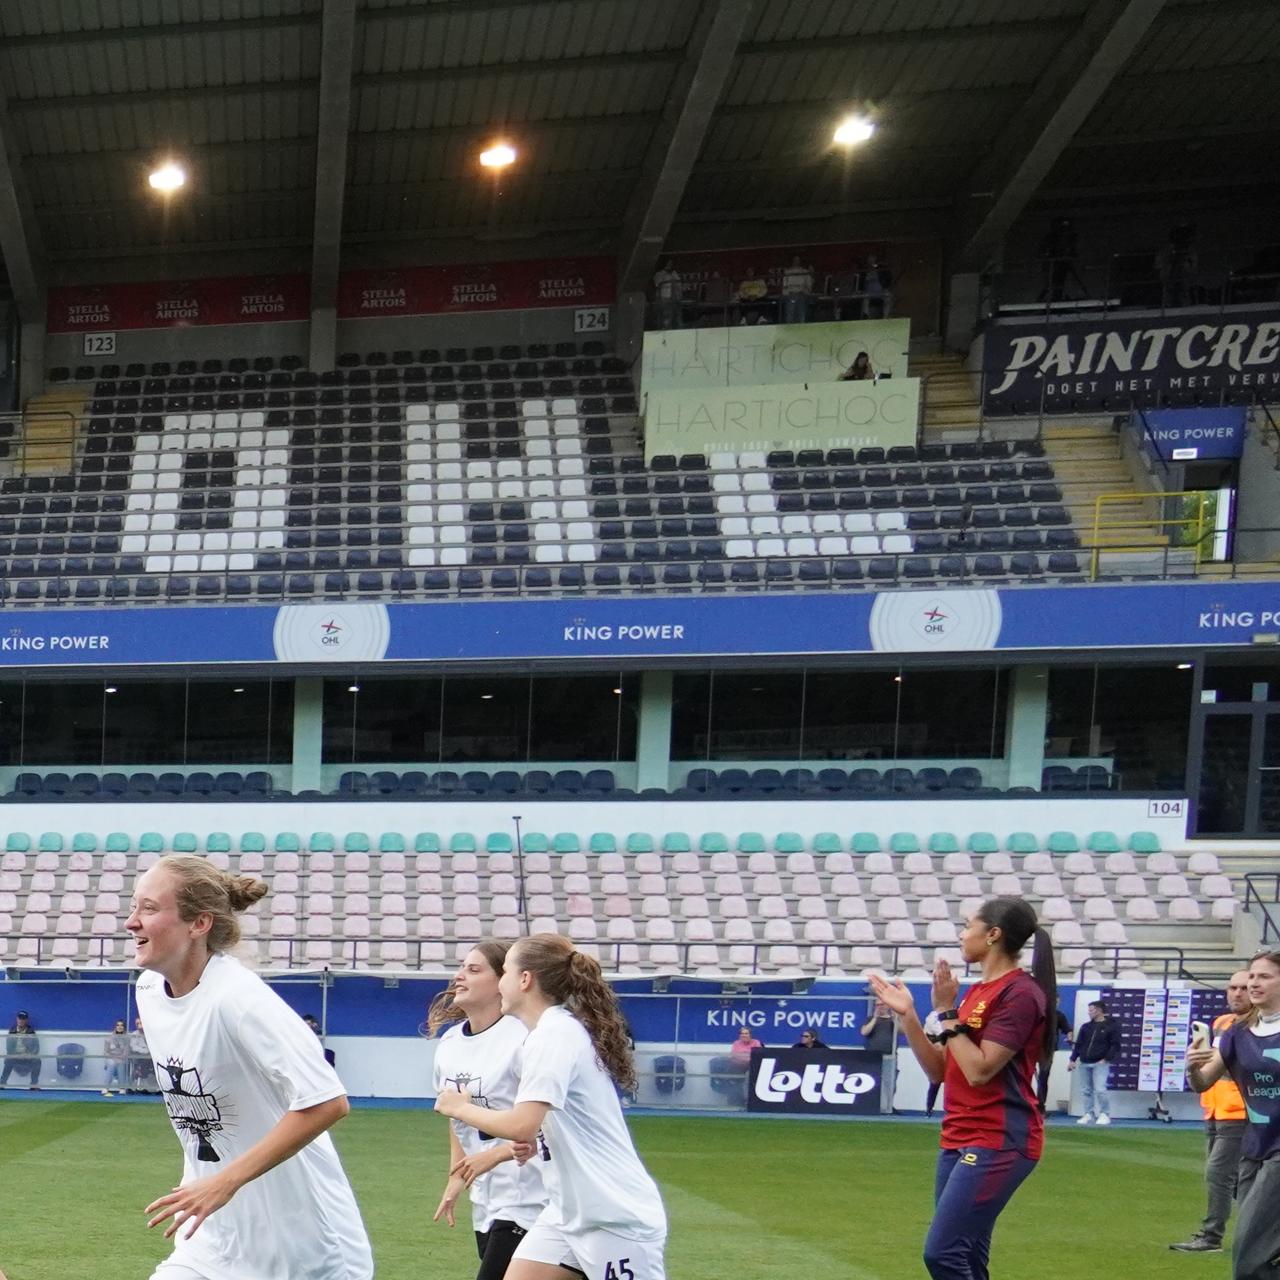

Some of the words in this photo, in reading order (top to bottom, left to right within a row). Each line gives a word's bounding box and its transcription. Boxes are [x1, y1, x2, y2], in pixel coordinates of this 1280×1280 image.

[577, 313, 607, 328] 124
[87, 337, 113, 351] 123
[1047, 382, 1097, 395] DOET
[1115, 379, 1152, 391] HET
[1170, 376, 1210, 388] MET
[656, 394, 908, 433] HARTICHOC
[1185, 427, 1234, 439] POWER
[1199, 612, 1253, 628] KING
[564, 626, 612, 641] KING
[618, 625, 684, 640] POWER
[924, 624, 945, 633] OHL
[2, 637, 45, 650] KING
[50, 635, 109, 649] POWER
[321, 636, 339, 645] OHL
[1152, 802, 1181, 814] 104
[707, 1010, 766, 1027] KING
[774, 1011, 856, 1028] POWER
[754, 1058, 876, 1104] lotto
[1254, 1072, 1273, 1083] Pro
